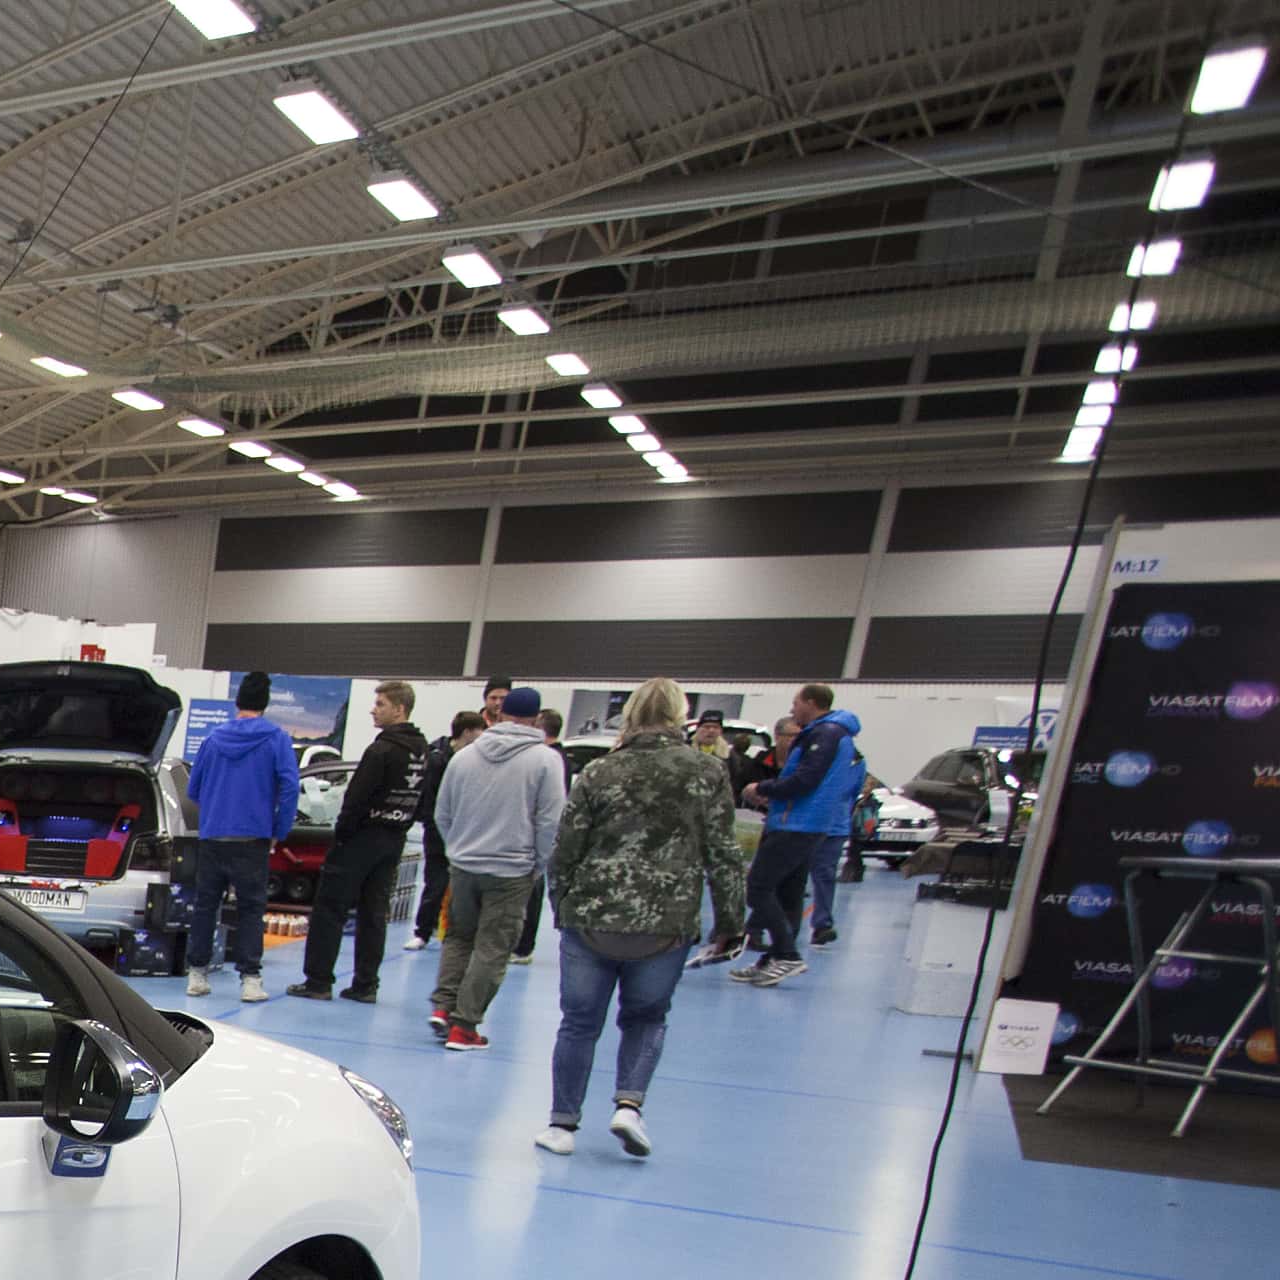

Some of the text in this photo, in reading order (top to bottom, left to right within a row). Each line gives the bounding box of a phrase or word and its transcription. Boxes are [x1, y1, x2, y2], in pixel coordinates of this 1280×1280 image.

[1113, 559, 1160, 574] M:17
[1148, 695, 1273, 708] VIASAT FILM
[1111, 831, 1182, 843] VIASAT
[14, 890, 71, 907] WOODMAN
[1171, 1032, 1246, 1050] VIAST
